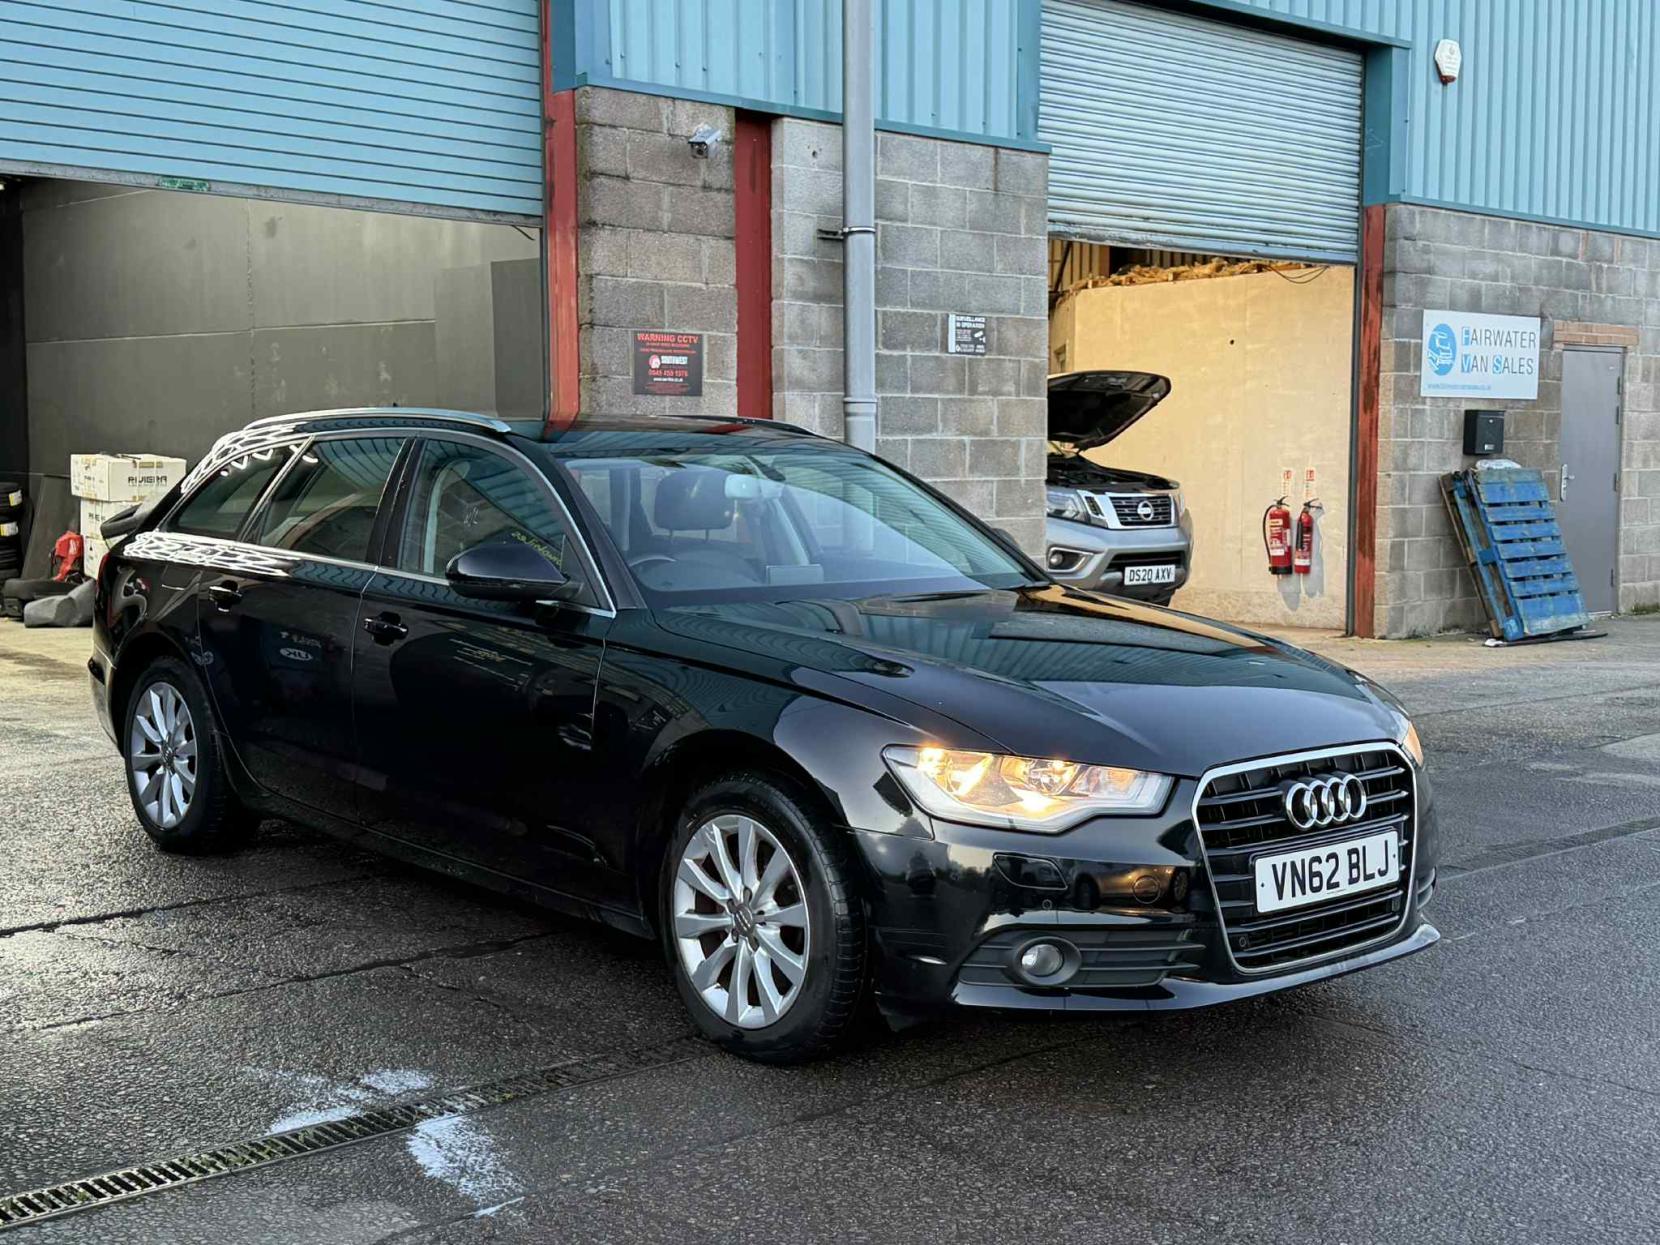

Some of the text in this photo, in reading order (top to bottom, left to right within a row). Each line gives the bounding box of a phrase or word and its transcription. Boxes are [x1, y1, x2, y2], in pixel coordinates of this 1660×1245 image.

[637, 333, 698, 344] WARNING CCTV
[1462, 326, 1537, 349] FAIRWATER
[1461, 354, 1534, 375] VAN SALES
[1129, 567, 1172, 582] DS20 AXV
[1271, 840, 1389, 901] VN62 BLJ
